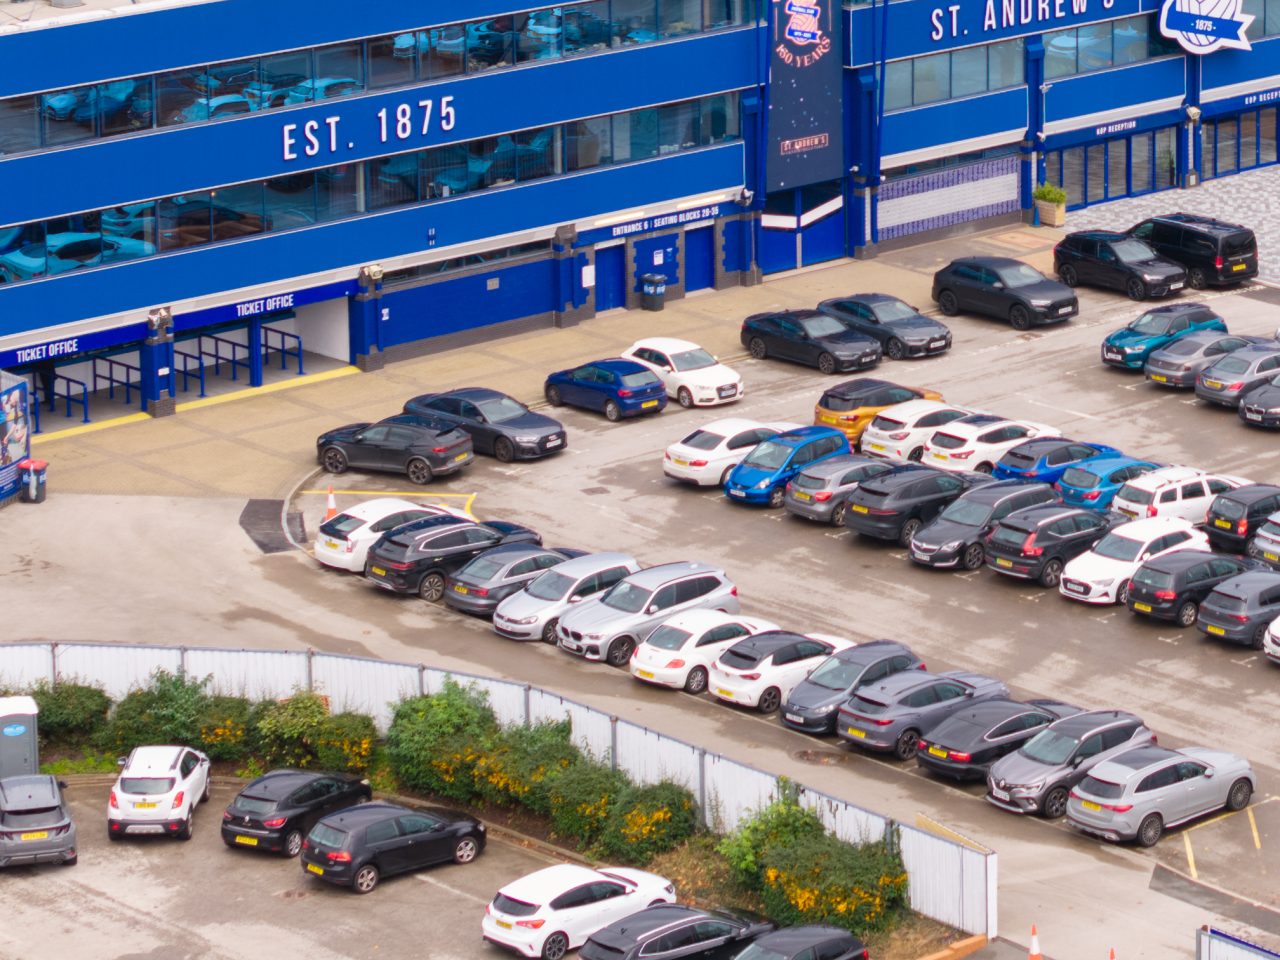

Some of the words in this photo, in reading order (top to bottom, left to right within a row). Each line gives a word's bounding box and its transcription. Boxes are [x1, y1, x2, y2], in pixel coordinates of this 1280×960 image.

[931, 5, 968, 41] ST.
[775, 43, 794, 65] 150
[795, 36, 832, 68] YEARS
[1244, 95, 1257, 105] KOP
[283, 115, 354, 161] EST.
[377, 95, 456, 142] 1875
[1108, 121, 1137, 133] RECEPTION
[612, 222, 643, 236] ENTRANCE
[653, 215, 678, 227] SEATING
[678, 210, 701, 223] BLOCKS
[236, 300, 265, 317] TICKET
[266, 294, 294, 312] OFFICE
[16, 345, 47, 364] TICKET
[48, 339, 79, 357] OFFICE
